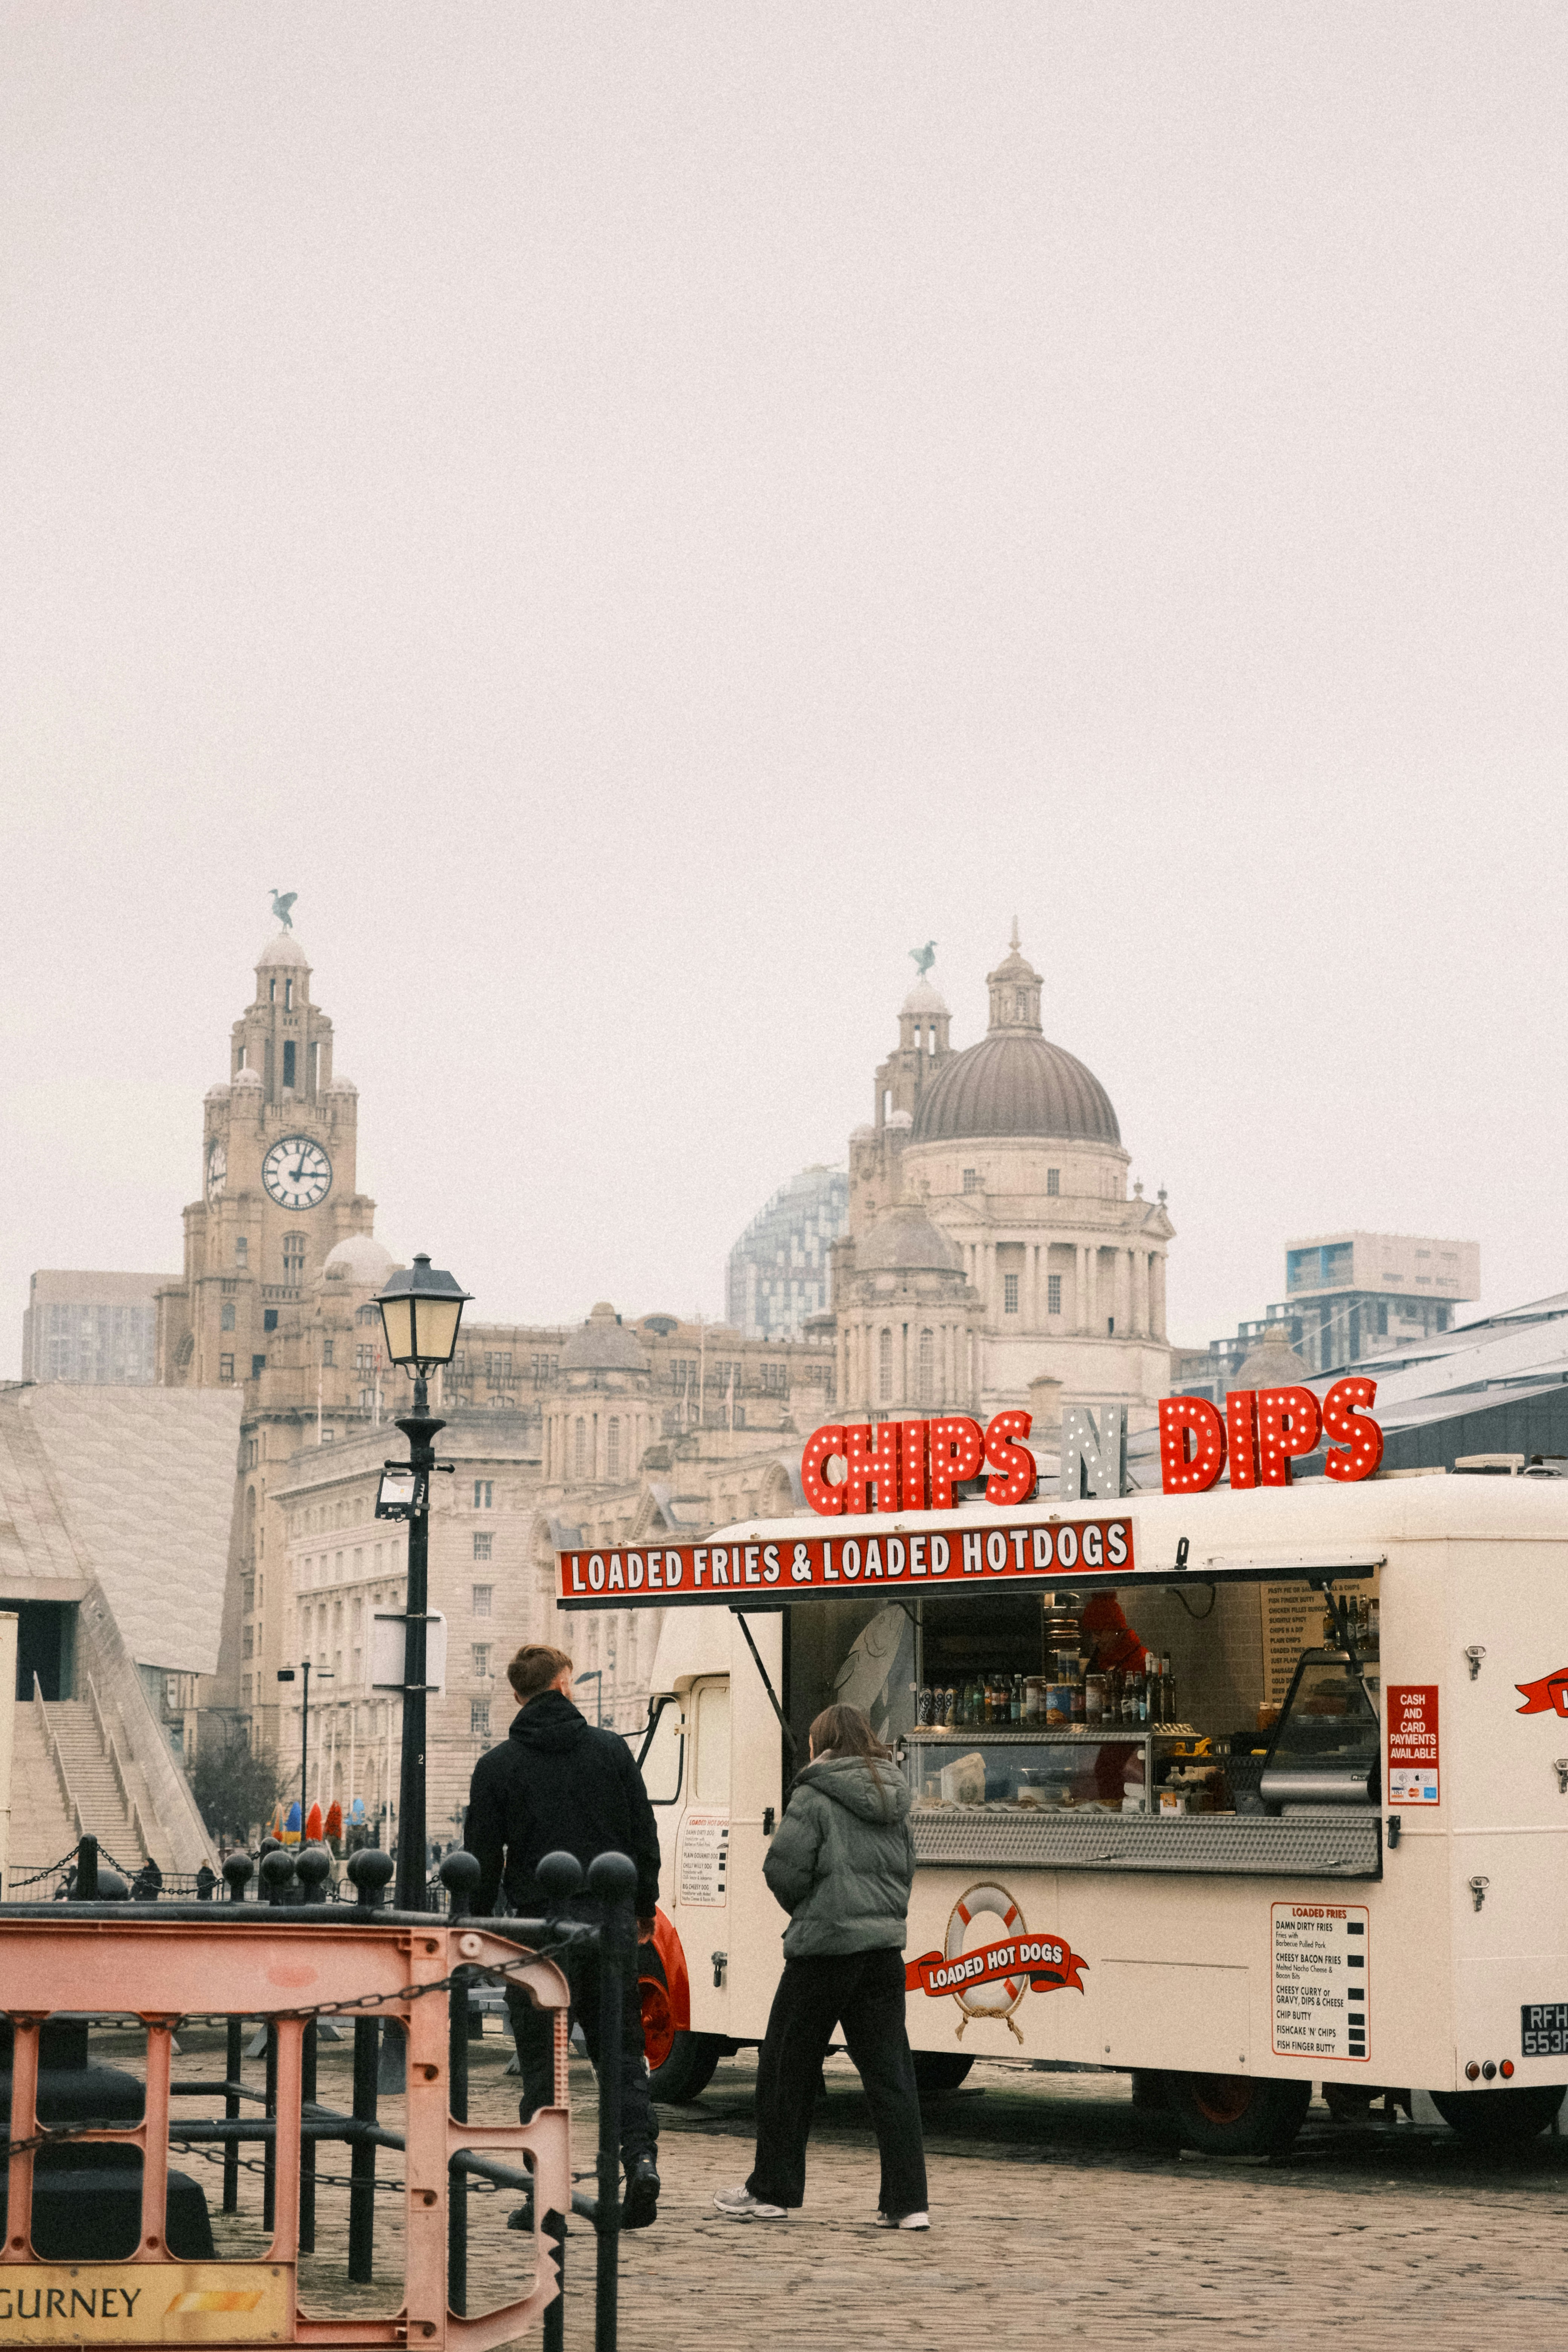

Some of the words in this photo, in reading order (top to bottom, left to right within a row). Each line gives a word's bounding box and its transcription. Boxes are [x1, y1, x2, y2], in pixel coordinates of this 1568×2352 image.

[802, 1410, 1036, 1516] CHIPS
[1060, 1404, 1128, 1501] N
[1159, 1377, 1384, 1494] DIPS
[572, 1550, 683, 1592] LOADED
[694, 1543, 780, 1587] FRIES
[790, 1543, 813, 1581] &
[823, 1535, 951, 1581] LOADED
[963, 1522, 1129, 1572] HOTDOGS
[1400, 1694, 1425, 1705] CASH
[1404, 1708, 1422, 1719] AND
[1400, 1722, 1425, 1733] CARD
[1390, 1733, 1436, 1745] PAYMENTS
[418, 1754, 424, 1764] 2
[1390, 1748, 1436, 1759] AVAILABLE
[1420, 1774, 1430, 1783] Pay
[1292, 1907, 1325, 1918] LOADED
[1326, 1909, 1347, 1919] FRIES
[1276, 1921, 1295, 1930] DAMN
[1297, 1922, 1315, 1931] DIRTY
[1317, 1922, 1333, 1932] FRIES
[1299, 1940, 1314, 1948] Pulled
[1276, 1953, 1298, 1963] CHEESY
[1300, 1954, 1323, 1964] BACON
[1325, 1955, 1341, 1965] FRIES
[929, 1956, 984, 1989] LOADED
[987, 1946, 1016, 1971] HOT
[1020, 1943, 1063, 1964] DOGS
[1276, 1985, 1299, 1995] CHEESY
[1301, 1986, 1321, 1996] CURRY
[1276, 1995, 1300, 2006] GRAVY,
[1302, 1997, 1315, 2006] DIPS
[1317, 1998, 1321, 2006] &
[1322, 1998, 1344, 2007] CHEESE
[1277, 2010, 1291, 2019] CHIP
[1292, 2011, 1311, 2021] BUTTY
[1531, 2006, 1568, 2029] RFH
[1277, 2025, 1306, 2036] FISHCAKE
[1318, 2027, 1336, 2037] CHIPS
[1277, 2040, 1291, 2050] FISH
[1292, 2041, 1315, 2052] FINGER
[1316, 2043, 1335, 2053] BUTTY
